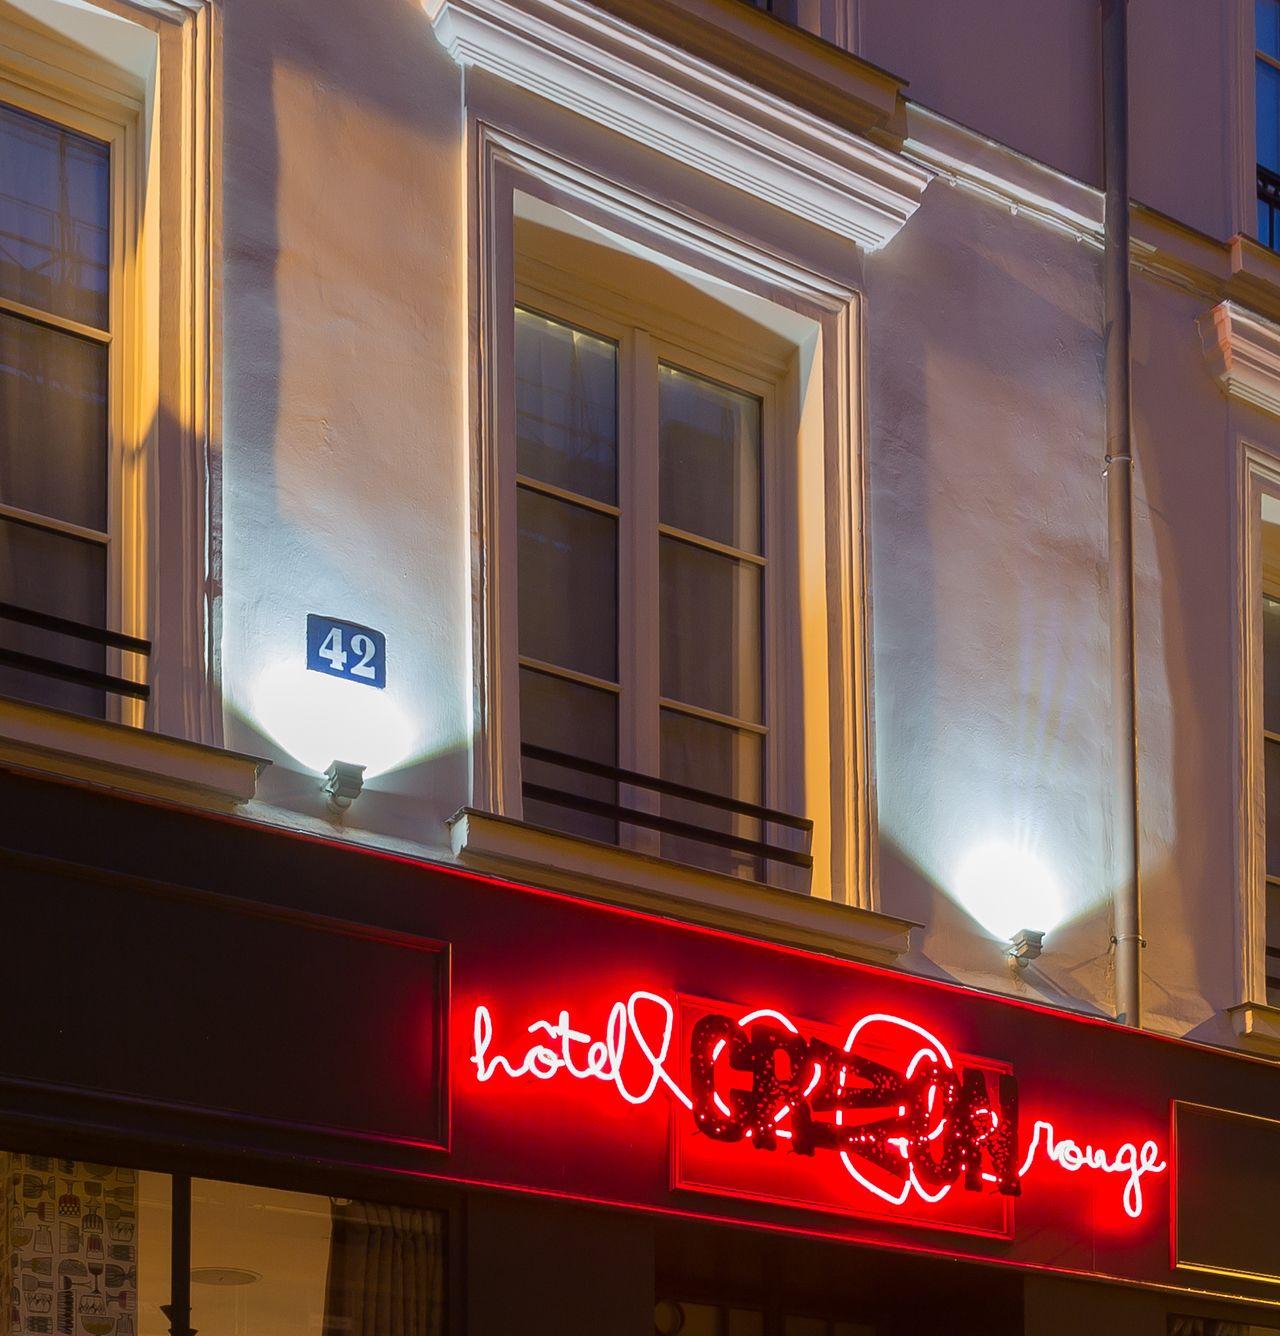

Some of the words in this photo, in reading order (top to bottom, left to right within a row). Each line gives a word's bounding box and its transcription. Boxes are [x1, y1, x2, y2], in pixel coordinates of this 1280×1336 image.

[318, 626, 377, 680] 42
[470, 991, 677, 1104] hôtel
[1020, 1121, 1166, 1218] rouge
